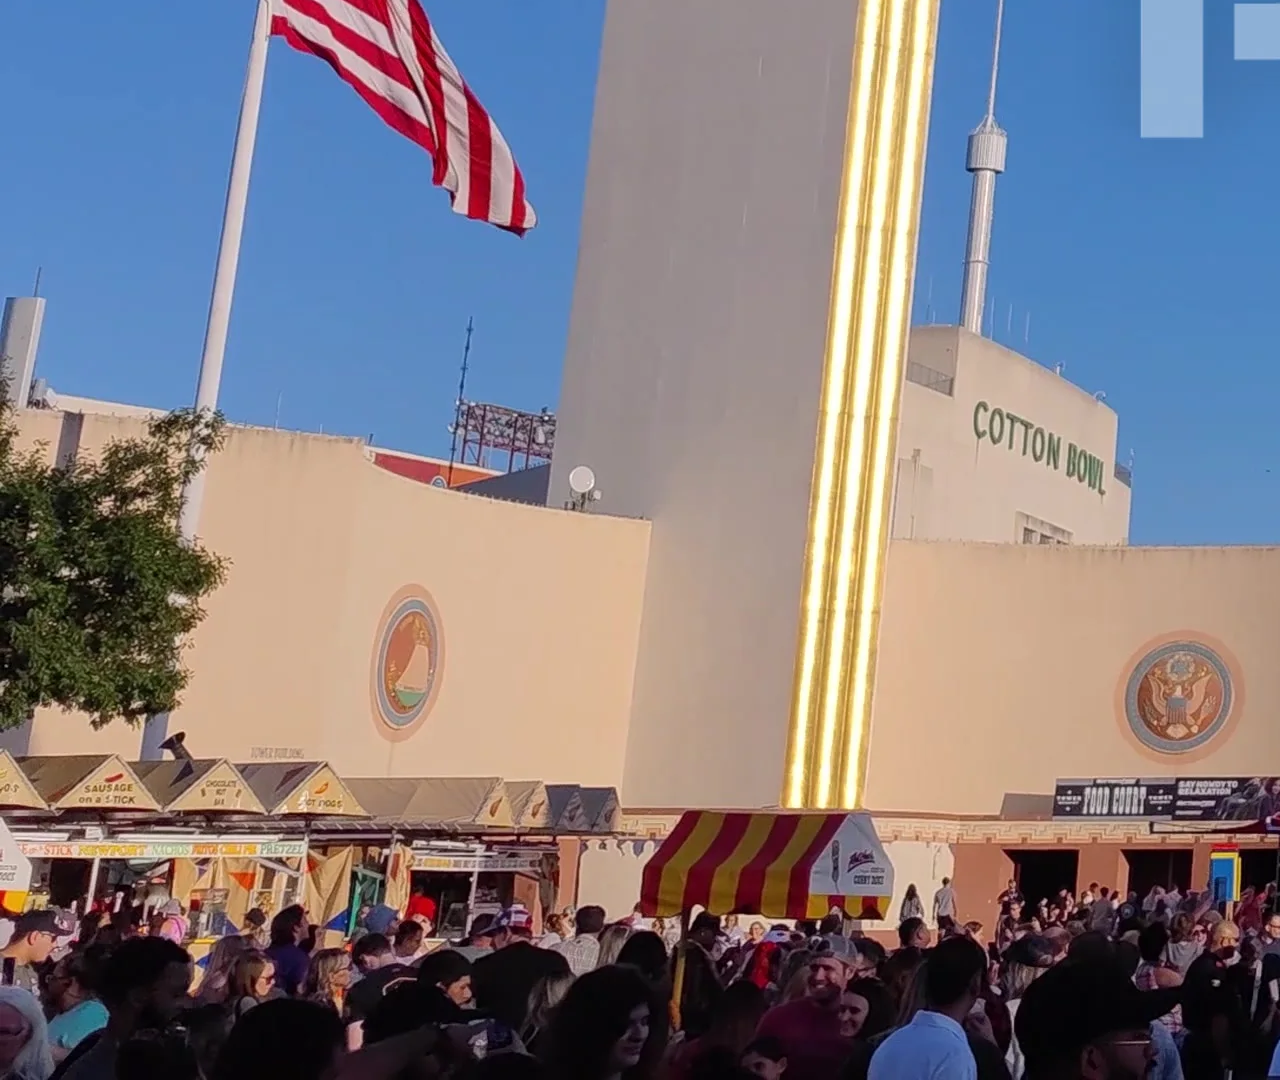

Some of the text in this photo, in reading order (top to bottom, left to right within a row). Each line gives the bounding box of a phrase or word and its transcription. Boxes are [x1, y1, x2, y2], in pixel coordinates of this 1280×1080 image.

[973, 401, 1106, 495] COTTON BOWL
[84, 784, 134, 793] SAUSAGE
[79, 796, 93, 804] on
[1083, 786, 1147, 814] FOOD COURT
[44, 844, 73, 855] STICK
[78, 844, 148, 856] NEWPORT
[151, 844, 190, 855] NACHOS
[260, 844, 303, 855] PRETZEL
